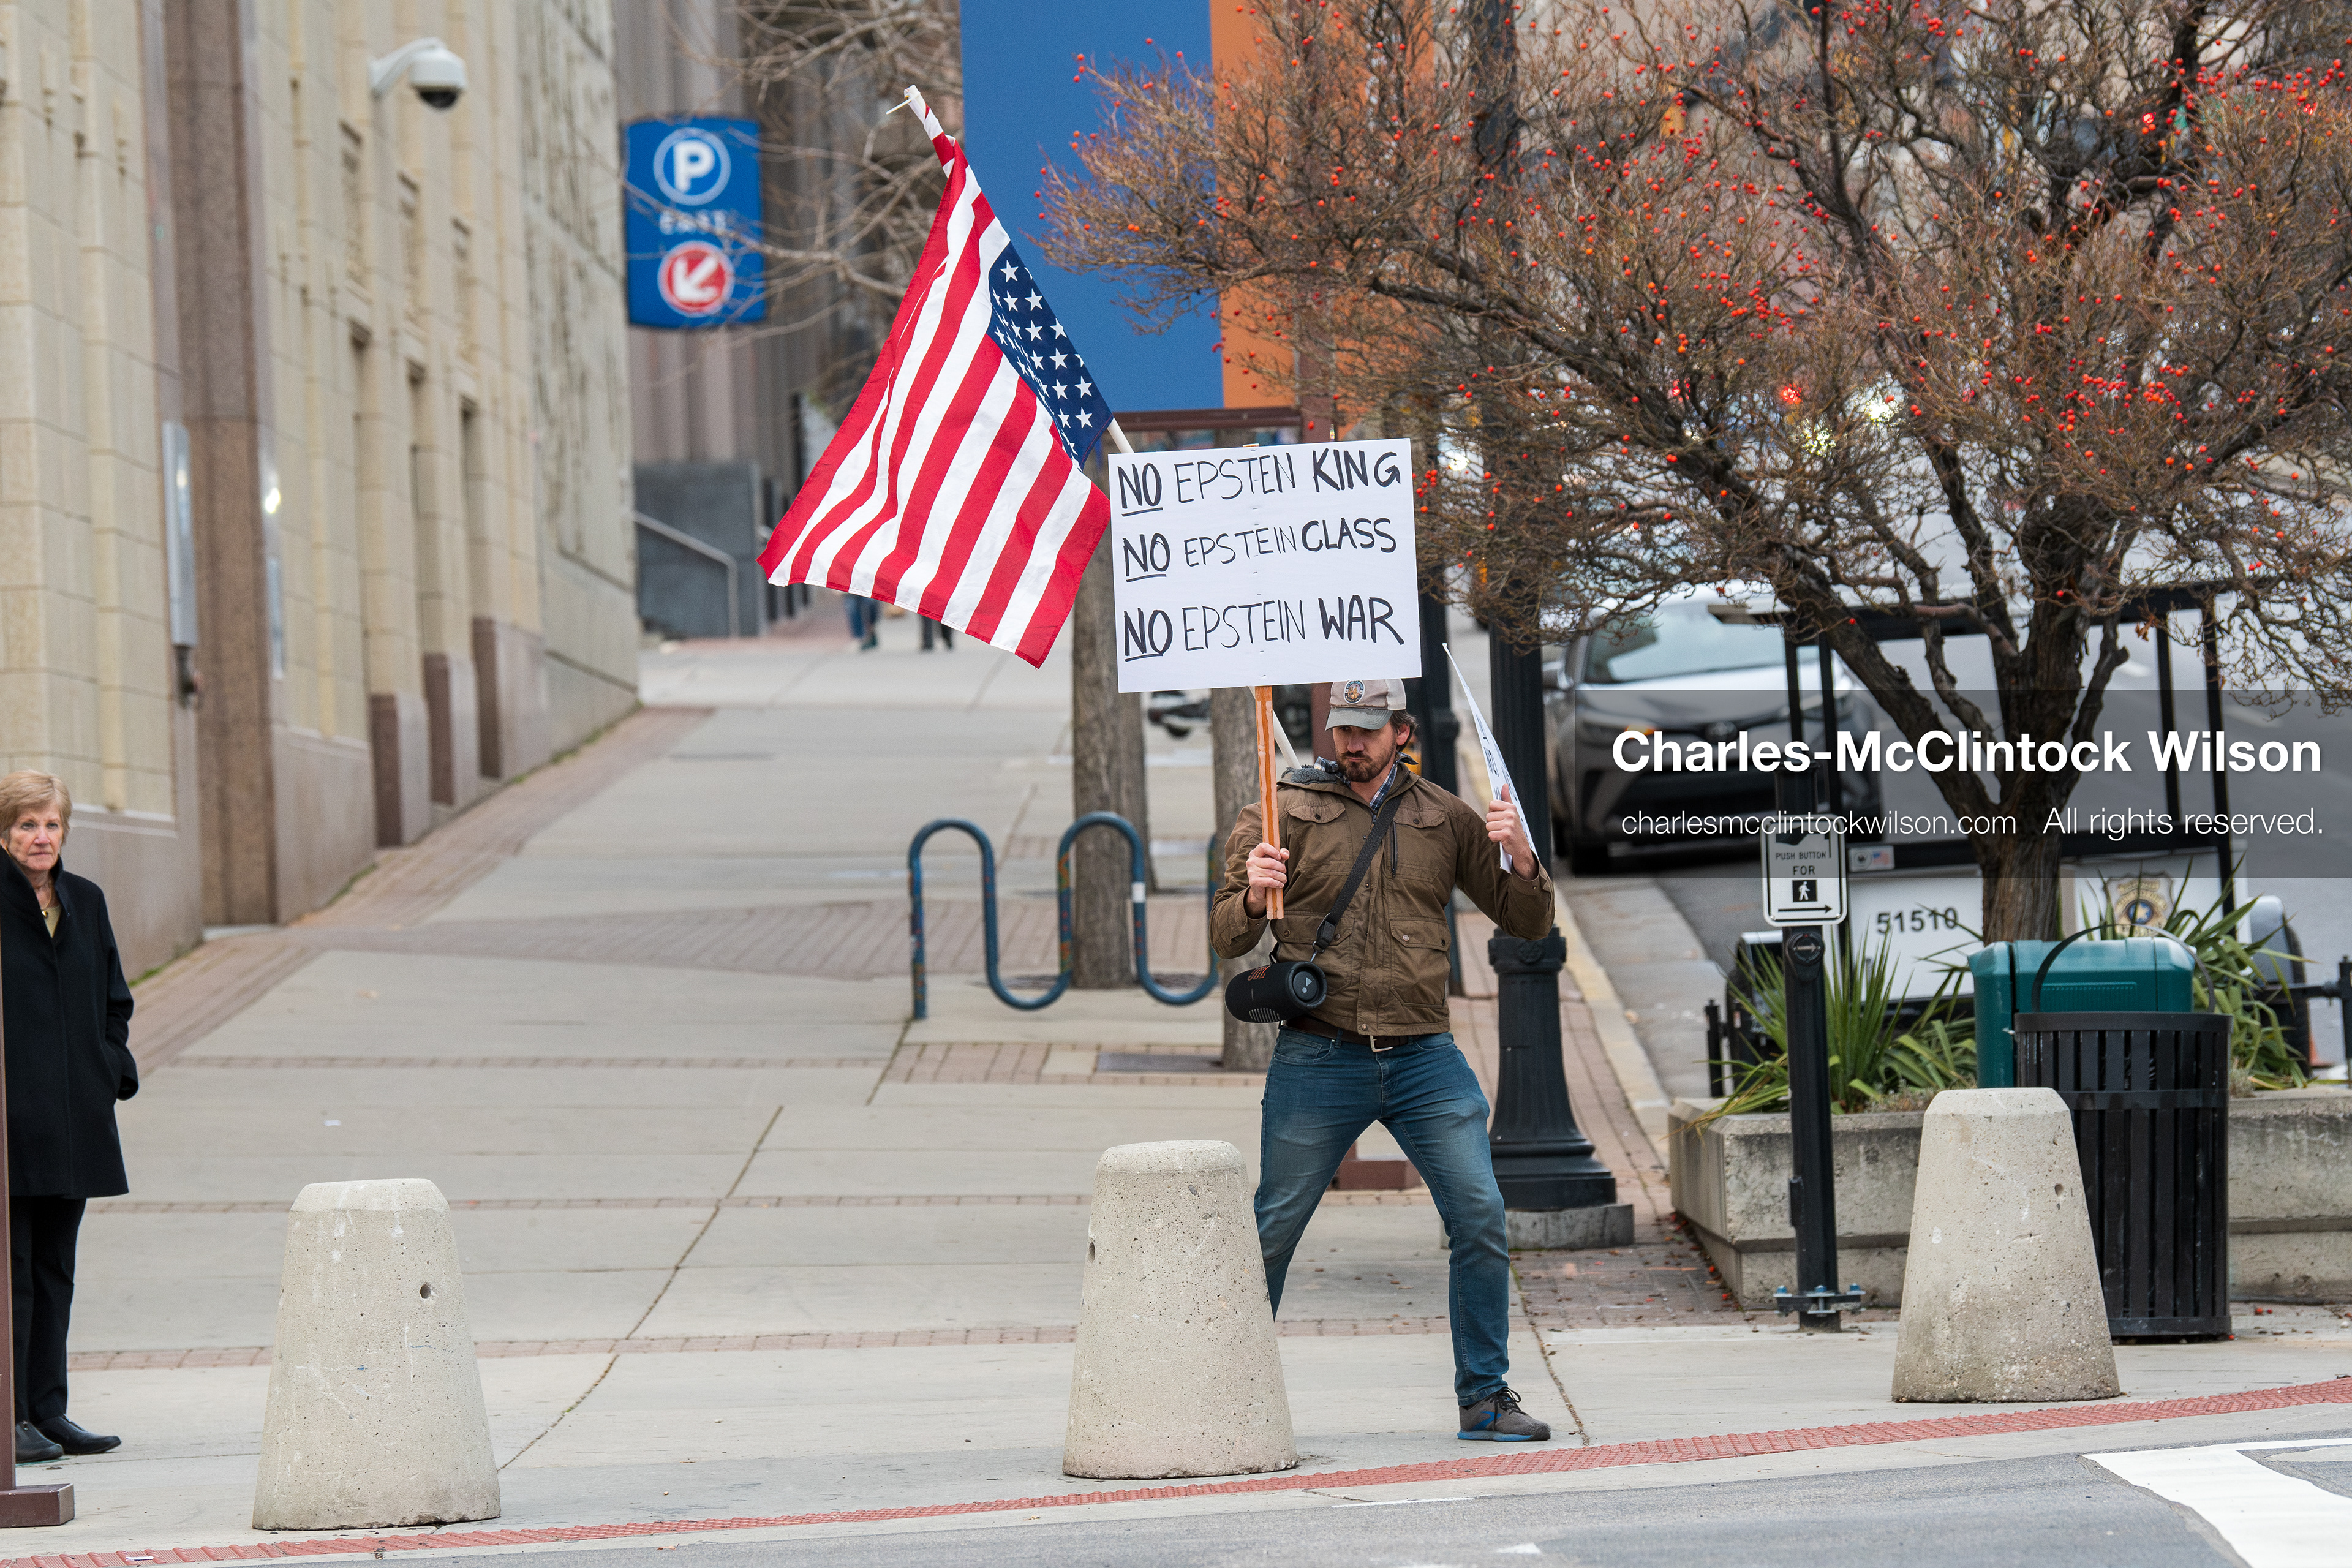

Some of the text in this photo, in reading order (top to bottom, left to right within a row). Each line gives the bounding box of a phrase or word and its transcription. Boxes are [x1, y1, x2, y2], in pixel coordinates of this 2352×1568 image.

[673, 139, 716, 193] P
[1118, 448, 1401, 510] NO EPSTEN KING
[1123, 518, 1396, 577] NO EPSTEIN CLASS
[1124, 595, 1404, 656] NO EPSTEIN WAR
[1776, 851, 1826, 860] PUSH BUTTON
[1793, 865, 1815, 875] FOR
[1877, 907, 1958, 935] 51510
